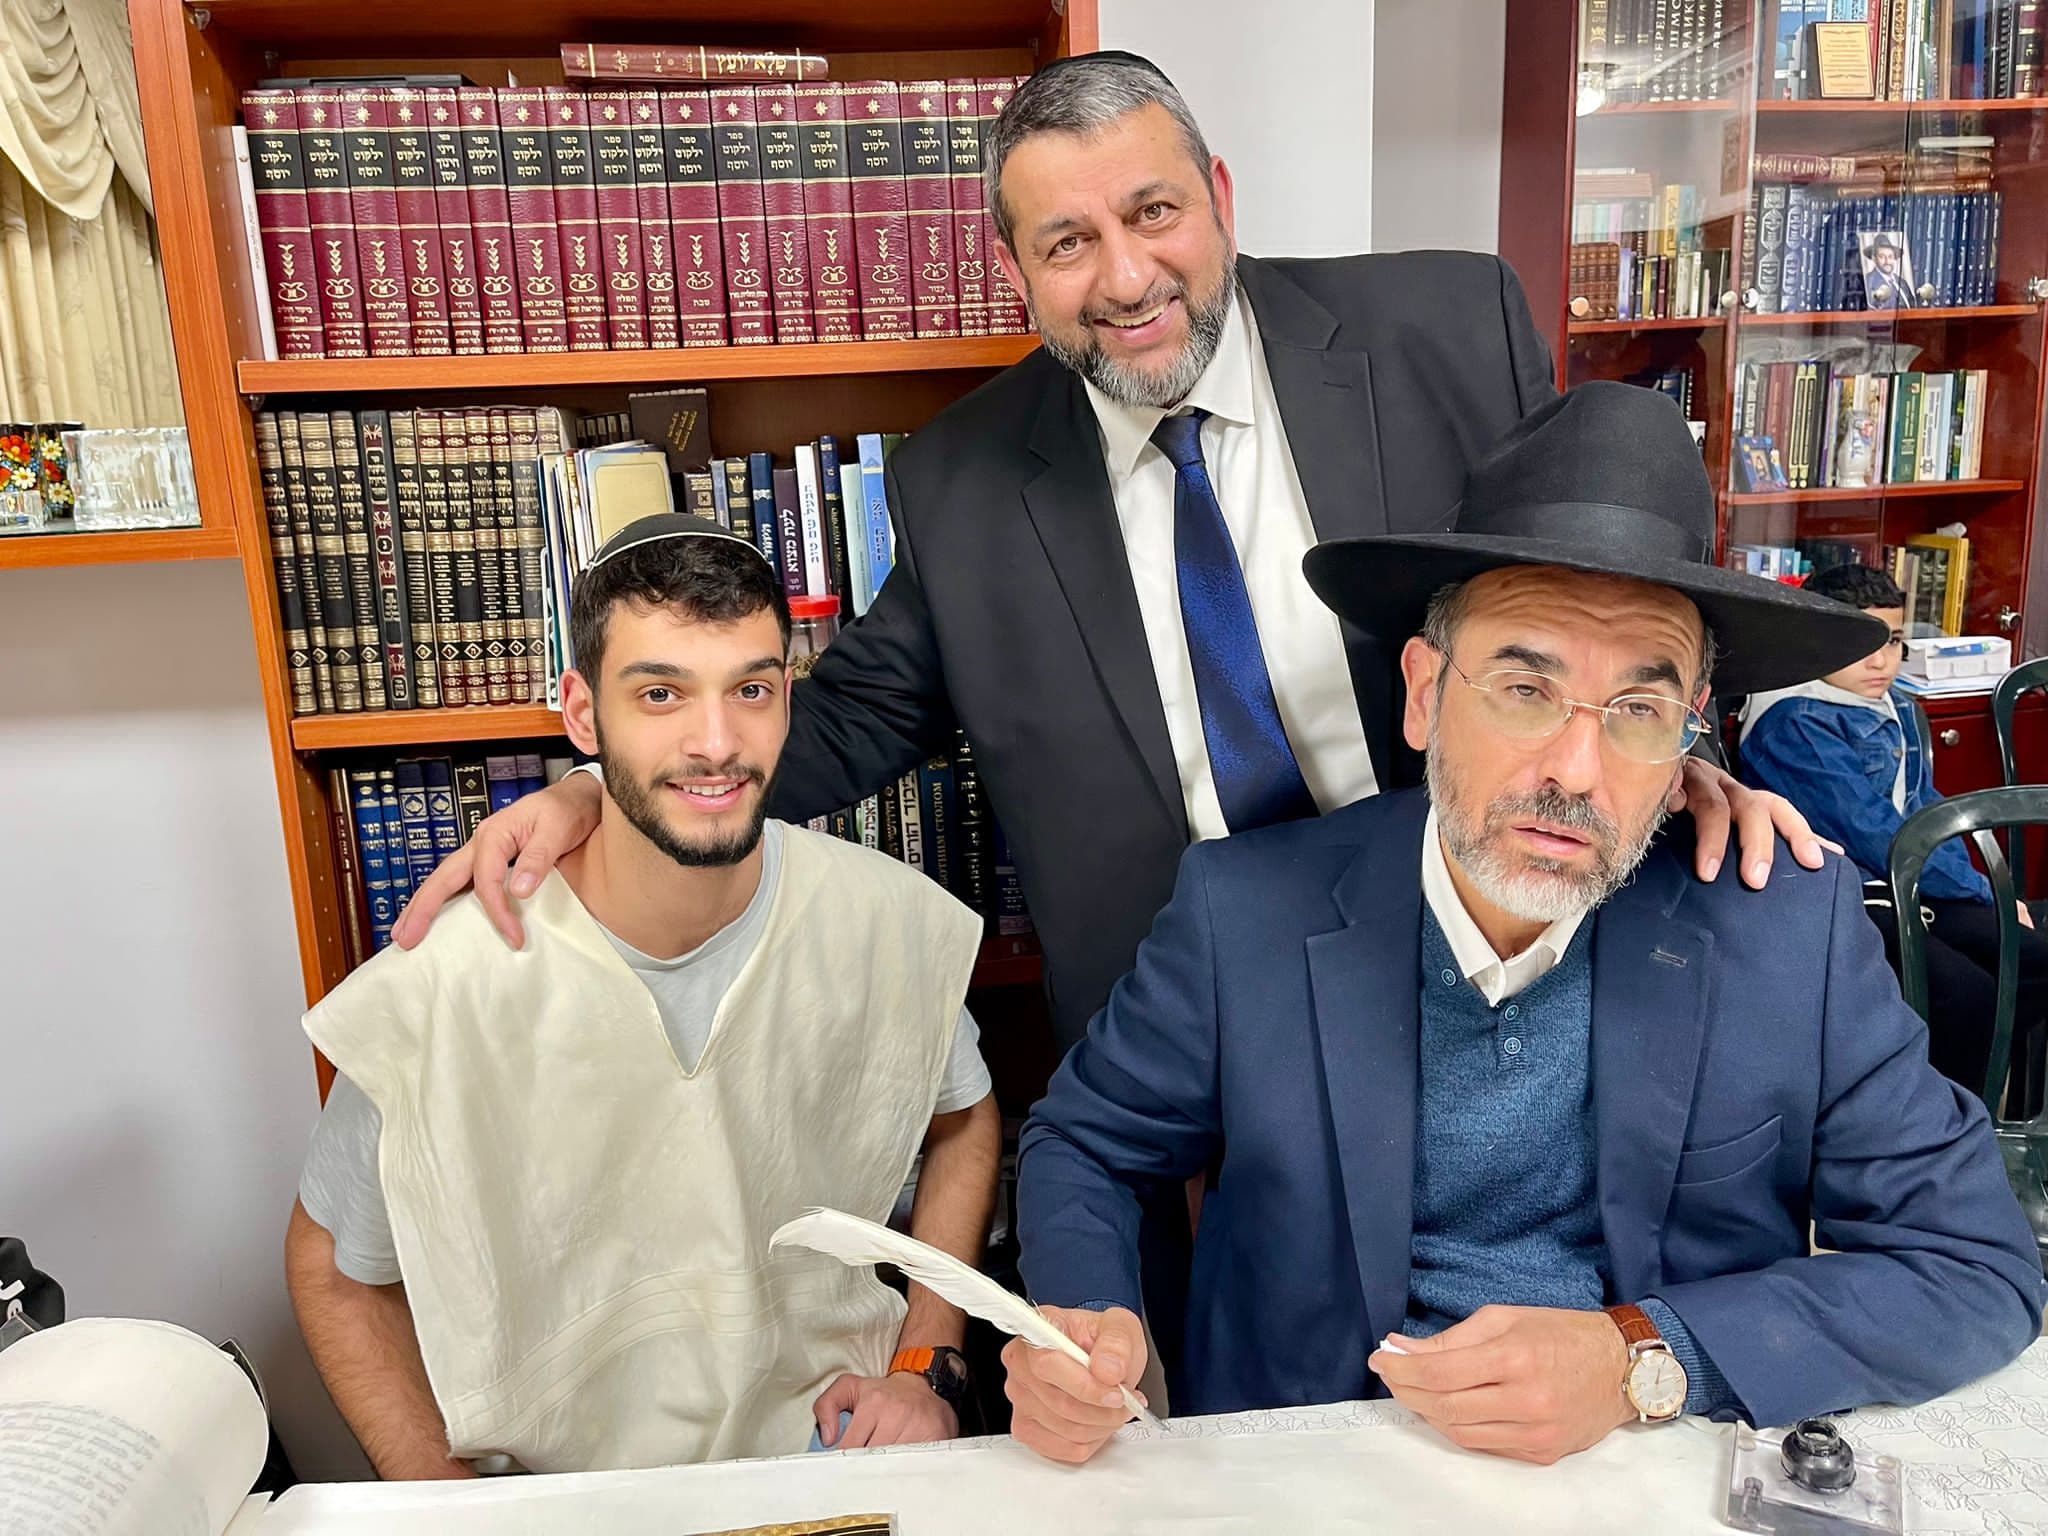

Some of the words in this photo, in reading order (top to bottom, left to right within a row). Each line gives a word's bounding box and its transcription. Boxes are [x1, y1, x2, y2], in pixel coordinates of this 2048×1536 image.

[957, 127, 972, 135] ספר
[314, 139, 331, 147] ספר
[722, 142, 750, 155] ילקוט
[767, 141, 794, 154] ילקוט
[810, 141, 838, 154] ילקוט
[862, 139, 889, 152] ילקוט
[914, 137, 941, 150] ילקוט
[952, 136, 978, 150] ילקוט
[261, 151, 291, 164] ילקוט
[310, 149, 339, 163] ילקוט
[354, 148, 383, 161] ילקוט
[396, 147, 425, 161] ילקוט
[468, 146, 497, 160] ילקוט
[512, 147, 542, 161] ילקוט
[556, 146, 585, 160] ילקוט
[600, 146, 628, 159] ילקוט
[635, 145, 663, 162] ילקוט
[675, 146, 703, 159] ילקוט
[727, 160, 749, 170] יוסף
[771, 160, 793, 170] יוסף
[815, 159, 836, 170] יוסף
[866, 157, 888, 167] יוסף
[918, 155, 939, 165] יוסף
[956, 155, 976, 164] יוסף
[266, 169, 290, 180] יוסף
[314, 168, 338, 179] יוסף
[358, 167, 382, 178] יוסף
[401, 167, 424, 177] יוסף
[472, 165, 496, 176] יוסף
[518, 166, 540, 177] יוסף
[561, 166, 584, 176] יוסף
[604, 165, 627, 175] יוסף
[639, 163, 662, 175] יוסף
[680, 165, 702, 175] יוסף
[778, 508, 796, 537] לעת
[807, 518, 817, 539] שם
[785, 539, 799, 573] מצוא
[809, 542, 819, 564] טוב
[931, 781, 945, 832] СТОЛОМ
[863, 799, 876, 830] לאכת
[905, 822, 921, 864] הורים
